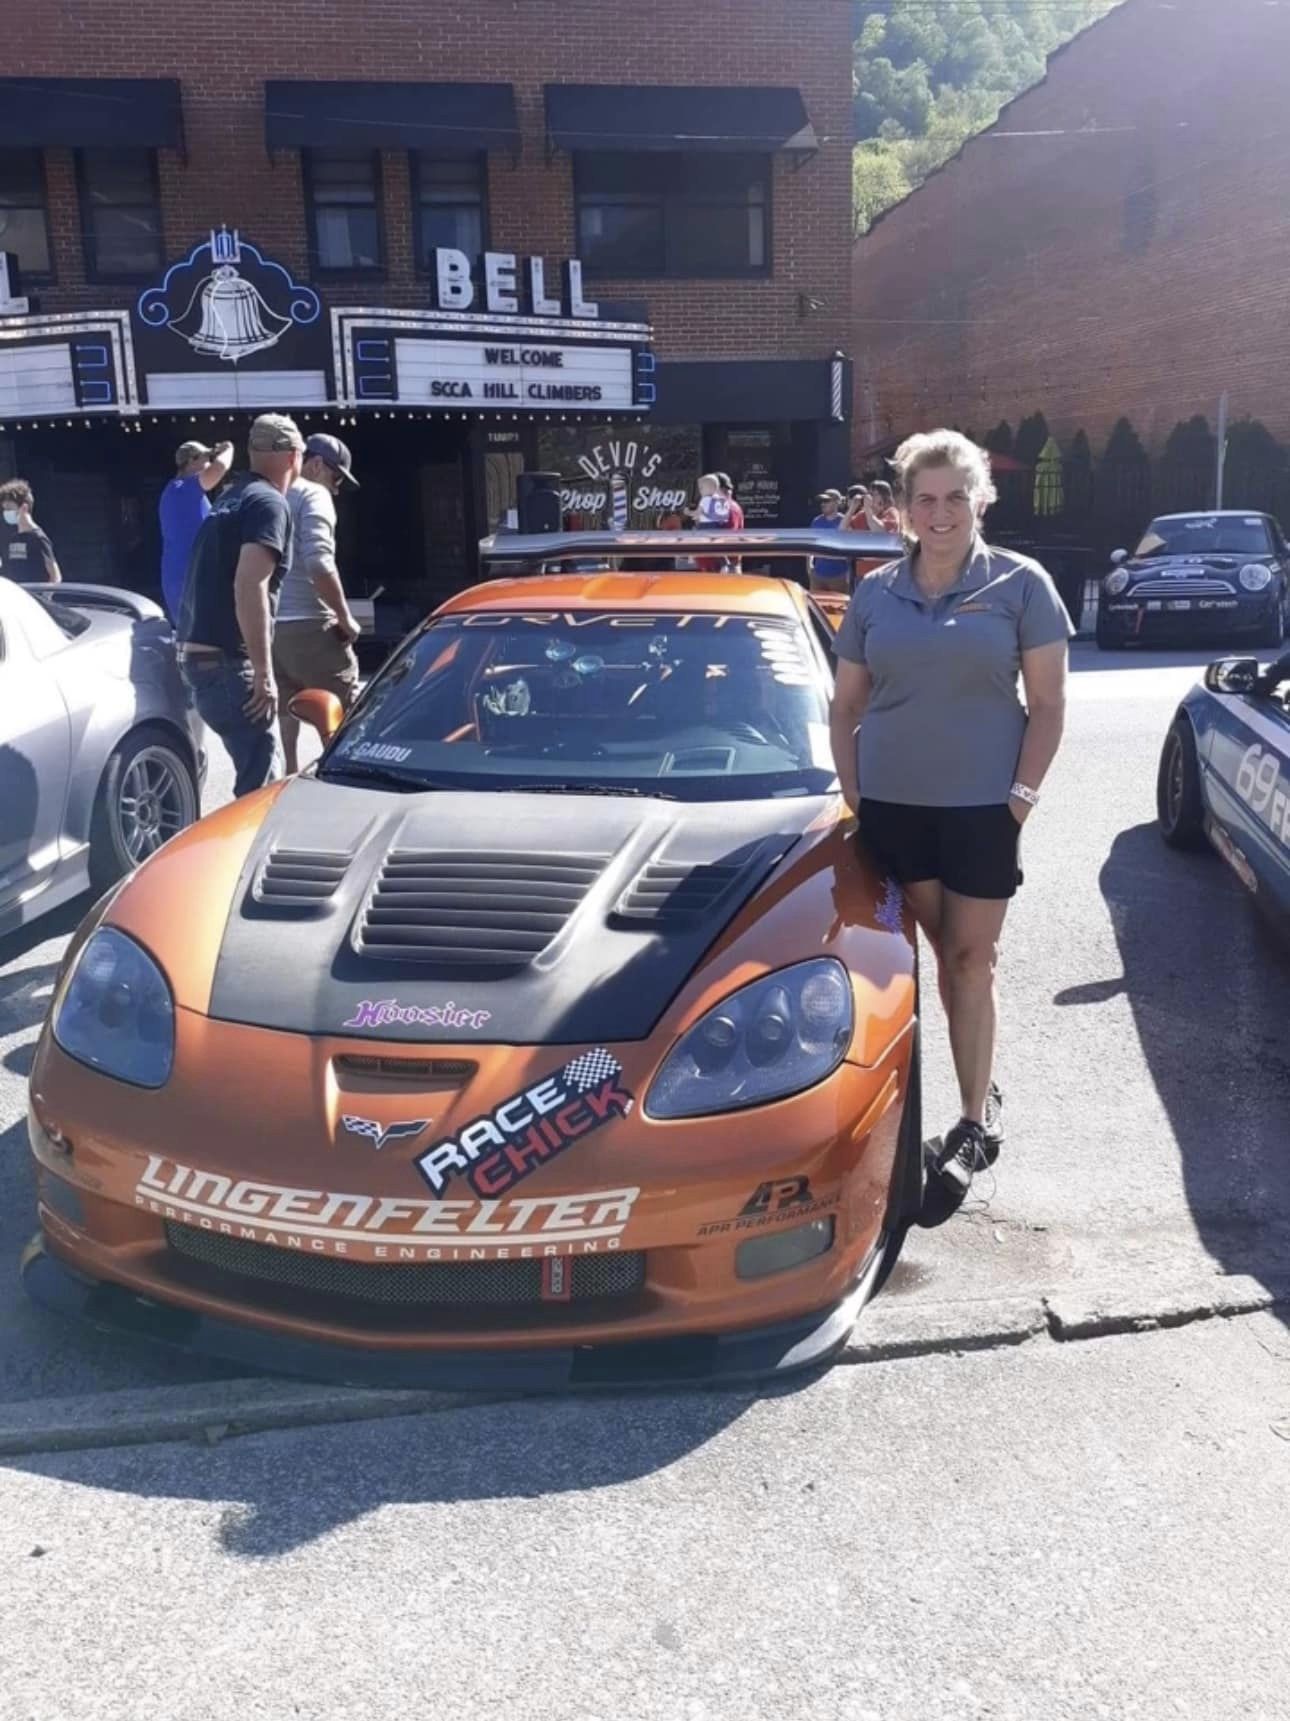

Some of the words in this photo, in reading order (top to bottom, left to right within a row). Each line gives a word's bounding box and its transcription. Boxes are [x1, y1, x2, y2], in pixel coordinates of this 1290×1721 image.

[436, 247, 599, 318] BELL
[484, 348, 563, 368] WELCOME
[431, 381, 472, 398] SCCA
[483, 383, 518, 399] HILL
[528, 384, 602, 401] CLIMBERS
[578, 440, 662, 479] DEVO'S
[633, 486, 687, 513] Shop
[343, 998, 491, 1030] Hoosier
[419, 1077, 566, 1190] RACE
[473, 1082, 630, 1195] CHICK
[140, 1154, 641, 1232] LINGENFELTER
[135, 1195, 348, 1254] PERFORMANCE
[375, 1238, 621, 1259] ENGINEERING
